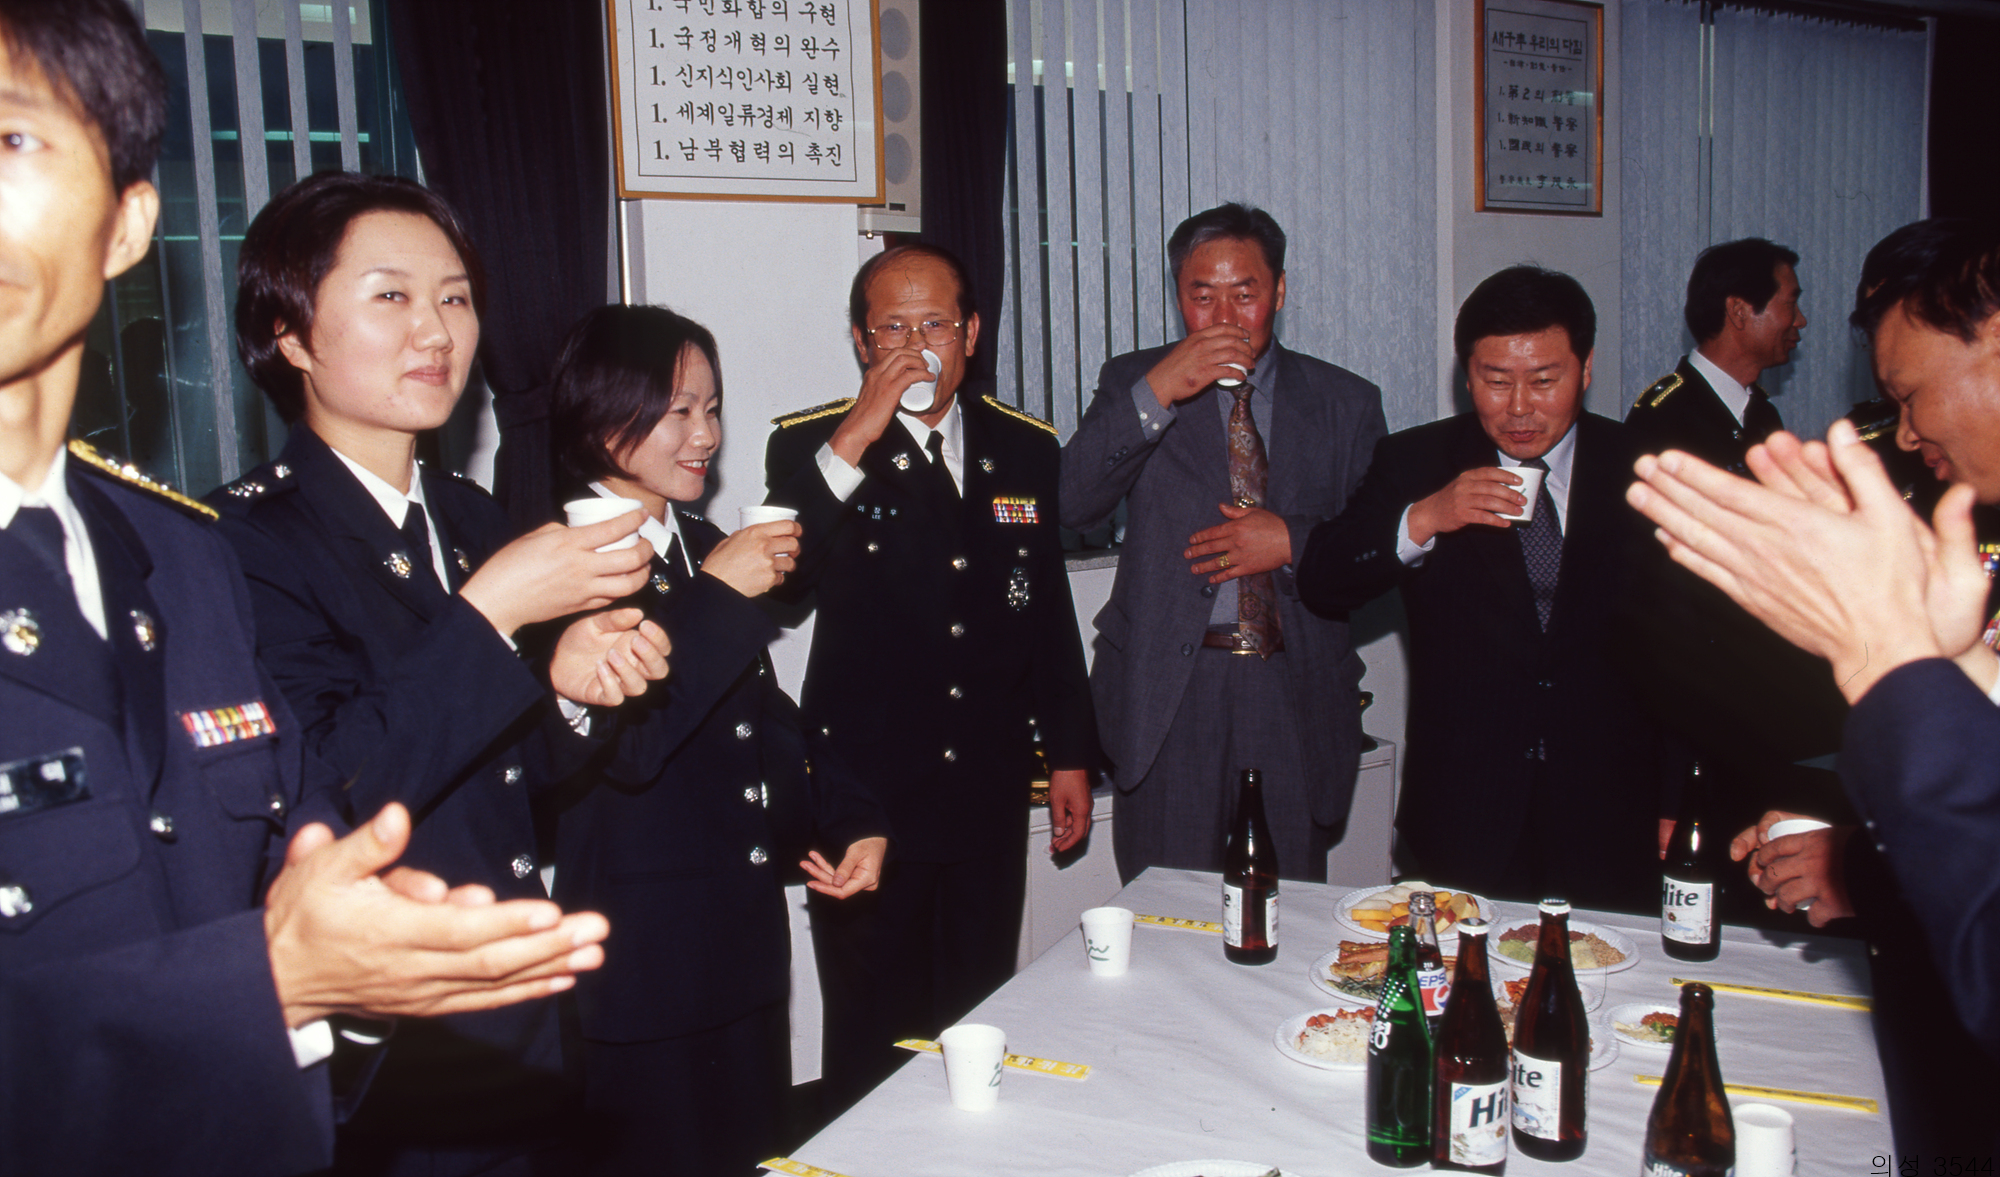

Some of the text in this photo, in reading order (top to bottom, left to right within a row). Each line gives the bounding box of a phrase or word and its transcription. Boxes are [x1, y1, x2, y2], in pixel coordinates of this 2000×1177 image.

[798, 1, 836, 26] 구현
[648, 26, 840, 61] 1. 국정개혁의 완수
[1529, 34, 1560, 54] 우리의
[1562, 38, 1583, 56] 다짐
[649, 63, 840, 96] 1. 신지식인사회 실현
[651, 100, 843, 132] 1. 세계일류경제 지향
[653, 137, 842, 167] 1. 남북협력의 촉진
[1419, 972, 1447, 987] EPS
[1511, 1055, 1544, 1088] ite
